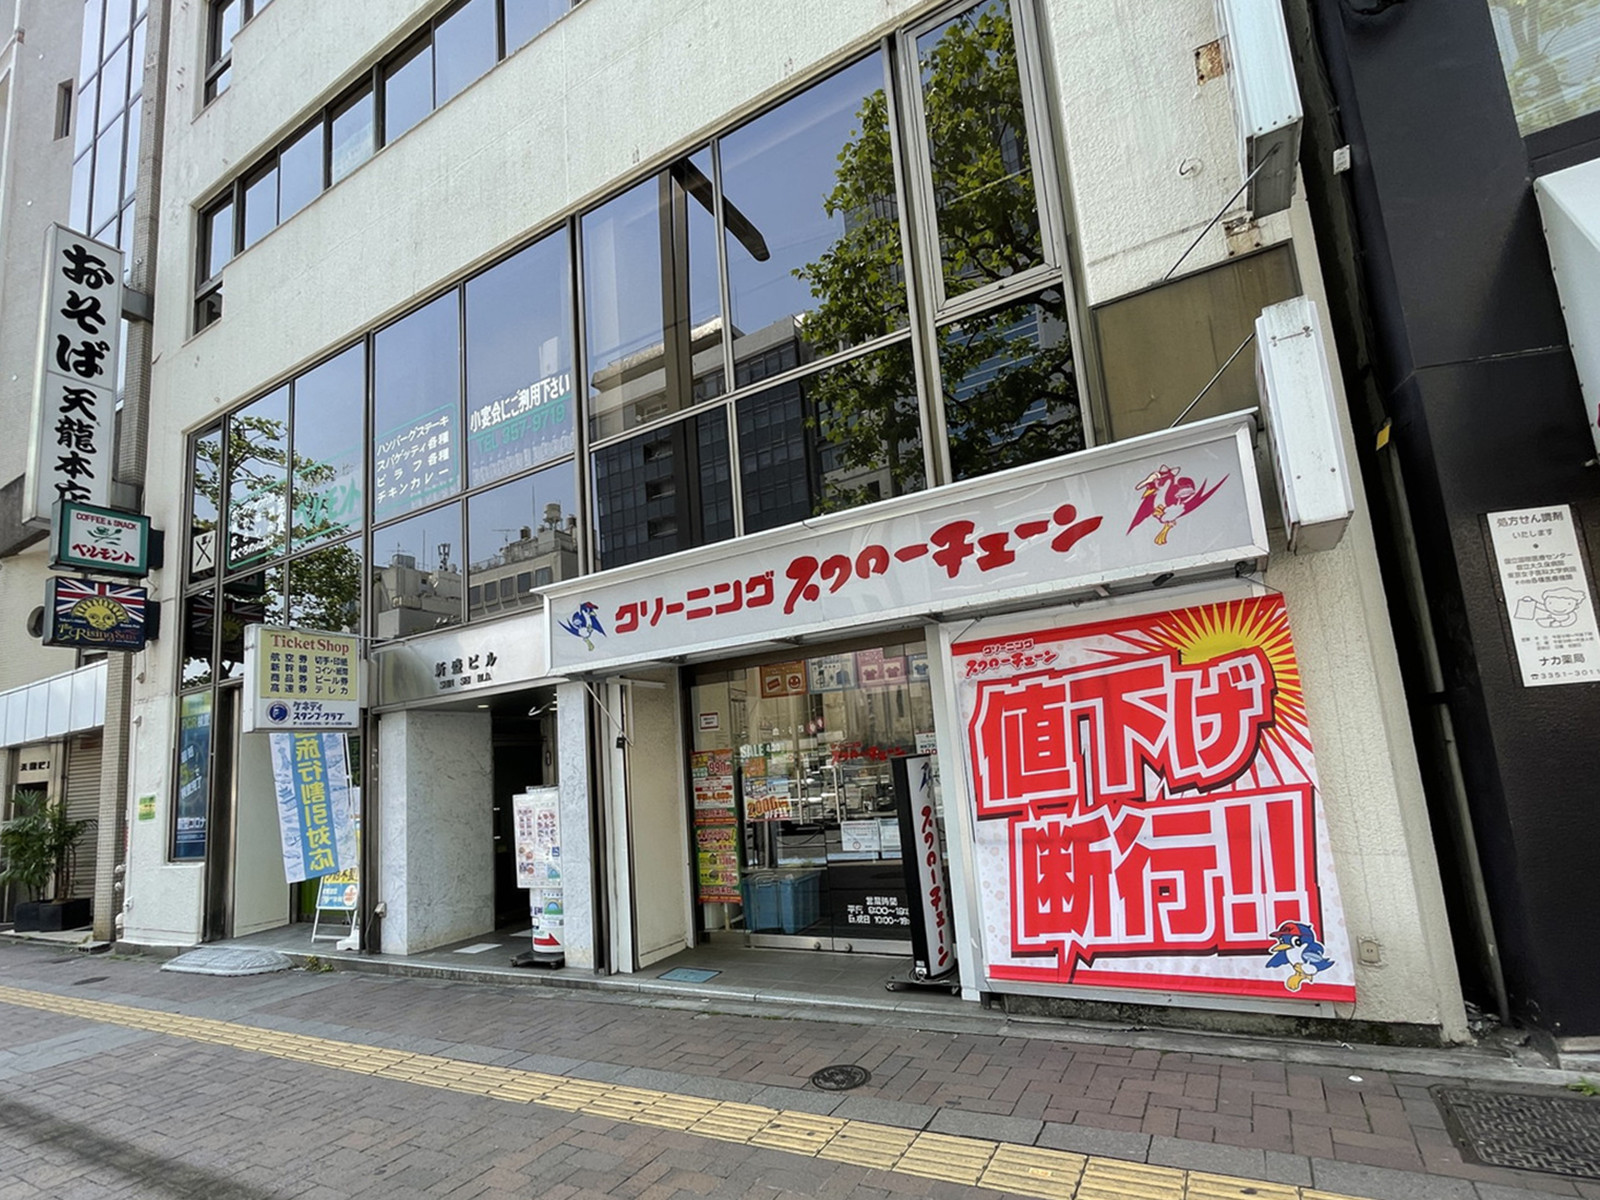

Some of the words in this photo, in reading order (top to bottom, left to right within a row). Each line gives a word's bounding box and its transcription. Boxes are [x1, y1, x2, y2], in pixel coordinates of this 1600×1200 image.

[56, 244, 115, 379] おそば
[376, 415, 449, 457] ハンバーグステーキ
[377, 467, 449, 504] チキンカレー
[76, 511, 107, 525] COFFEE
[113, 519, 138, 531] SNACK
[1496, 511, 1564, 528] 処方せん調剤
[1512, 528, 1553, 539] いたします
[72, 543, 136, 564] ベルモント
[615, 570, 775, 634] クリーニング
[783, 503, 1103, 614] スワローチェーン
[270, 633, 316, 651] Ticket
[316, 638, 350, 656] Shop
[983, 639, 1034, 655] クリーニング
[965, 649, 1059, 678] スワローチェーン
[1538, 653, 1586, 667] ナカ薬局
[315, 675, 349, 686] ビール券
[315, 685, 349, 696] テレカ
[293, 701, 323, 712] ケネディ
[975, 657, 1263, 804] 値下げ
[1020, 798, 1303, 942] 断行!!
[921, 805, 949, 967] スワローチェーン
